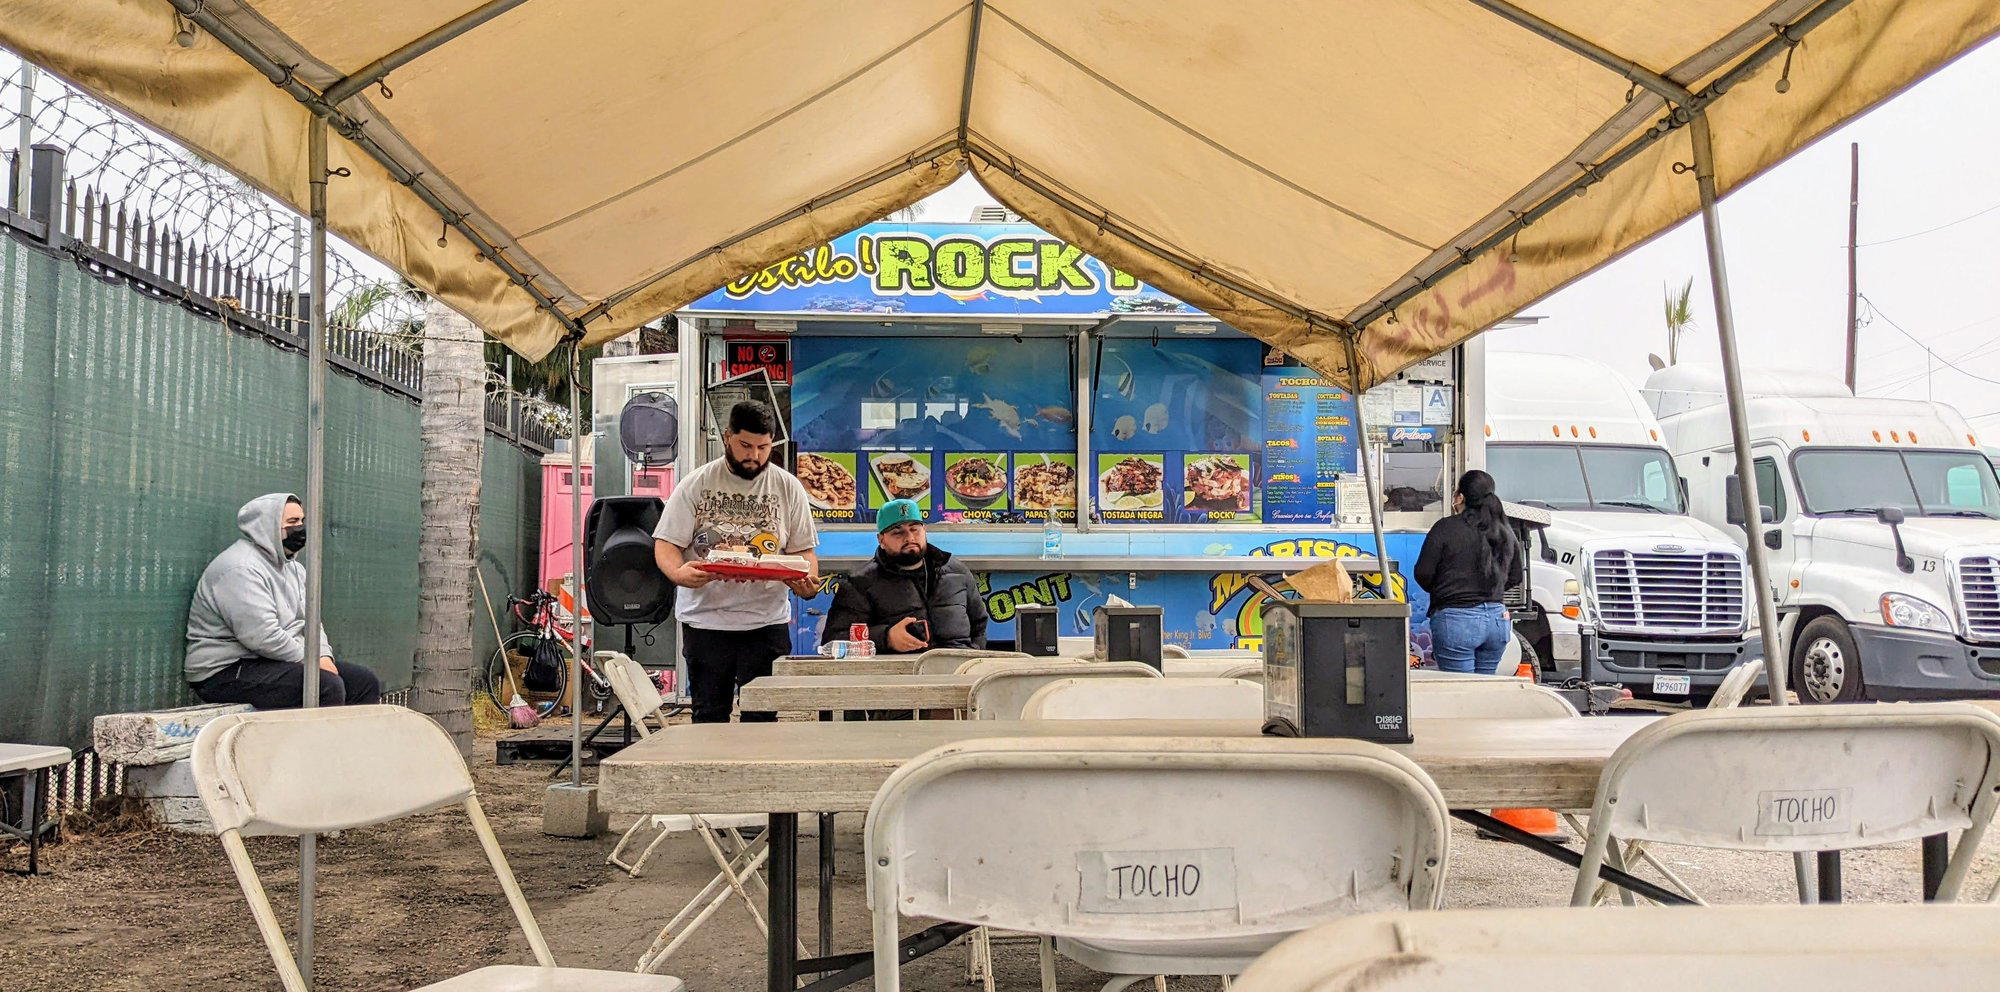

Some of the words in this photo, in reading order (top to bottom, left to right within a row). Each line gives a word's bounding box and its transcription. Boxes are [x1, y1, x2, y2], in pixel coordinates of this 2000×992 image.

[737, 345, 754, 361] NO
[731, 363, 784, 380] SMONG
[1279, 378, 1317, 386] TOCHO
[1428, 388, 1446, 407] A
[825, 510, 854, 518] GORDO
[962, 510, 993, 519] CHOYA
[1025, 510, 1048, 519] PAPAS
[1103, 511, 1135, 519] TOSTADA
[1137, 511, 1163, 519] NEGRA
[1208, 511, 1236, 519] ROCKY
[1922, 559, 1936, 573] 13
[986, 573, 1071, 621] OINT
[1773, 796, 1835, 822] TOCHO
[1111, 864, 1200, 899] TOCHO
